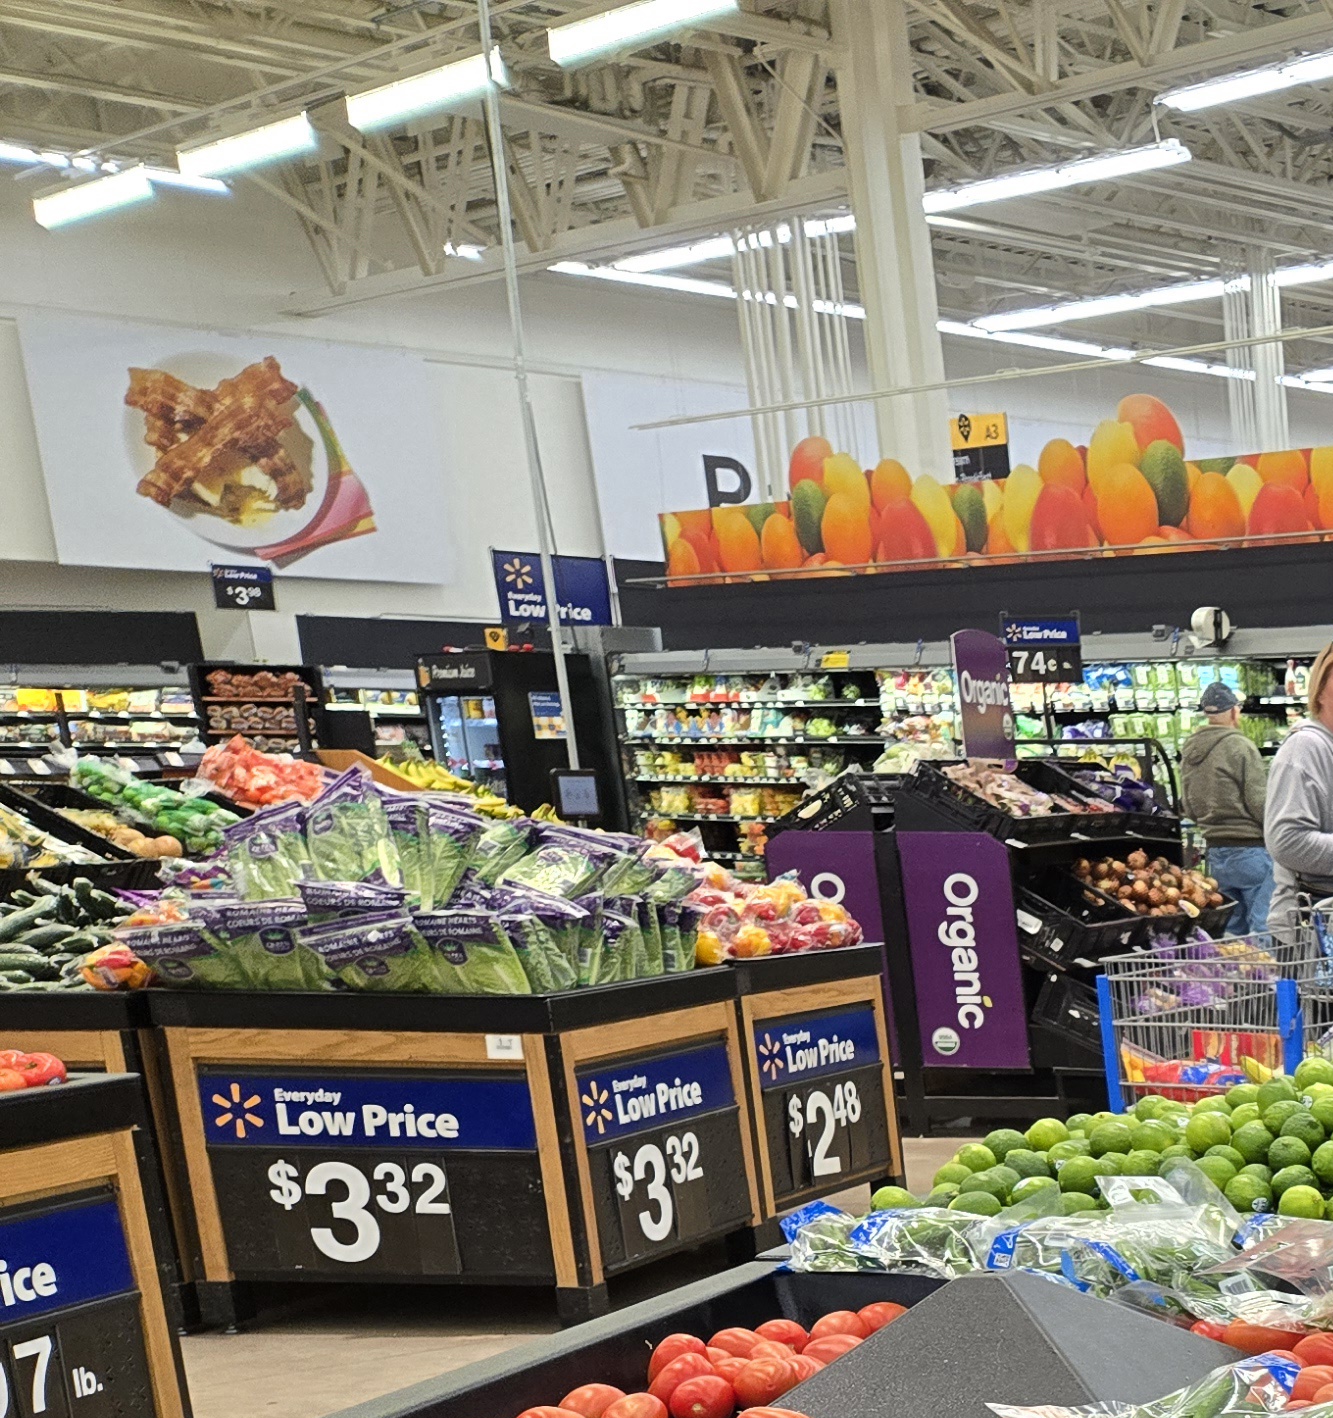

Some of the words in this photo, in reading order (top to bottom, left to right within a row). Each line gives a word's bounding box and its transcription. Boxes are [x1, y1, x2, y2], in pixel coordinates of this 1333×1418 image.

[984, 423, 999, 440] A3
[508, 600, 546, 618] Low
[961, 669, 1009, 714] Organic
[937, 872, 994, 1030] Organic
[784, 1042, 820, 1073] Low
[819, 1034, 856, 1067] Price
[274, 1087, 342, 1106] Everyday
[613, 1092, 657, 1125] Low
[655, 1077, 704, 1119] Price
[275, 1103, 356, 1136] Low
[361, 1103, 460, 1138] Price
[72, 1366, 104, 1399] lb.
